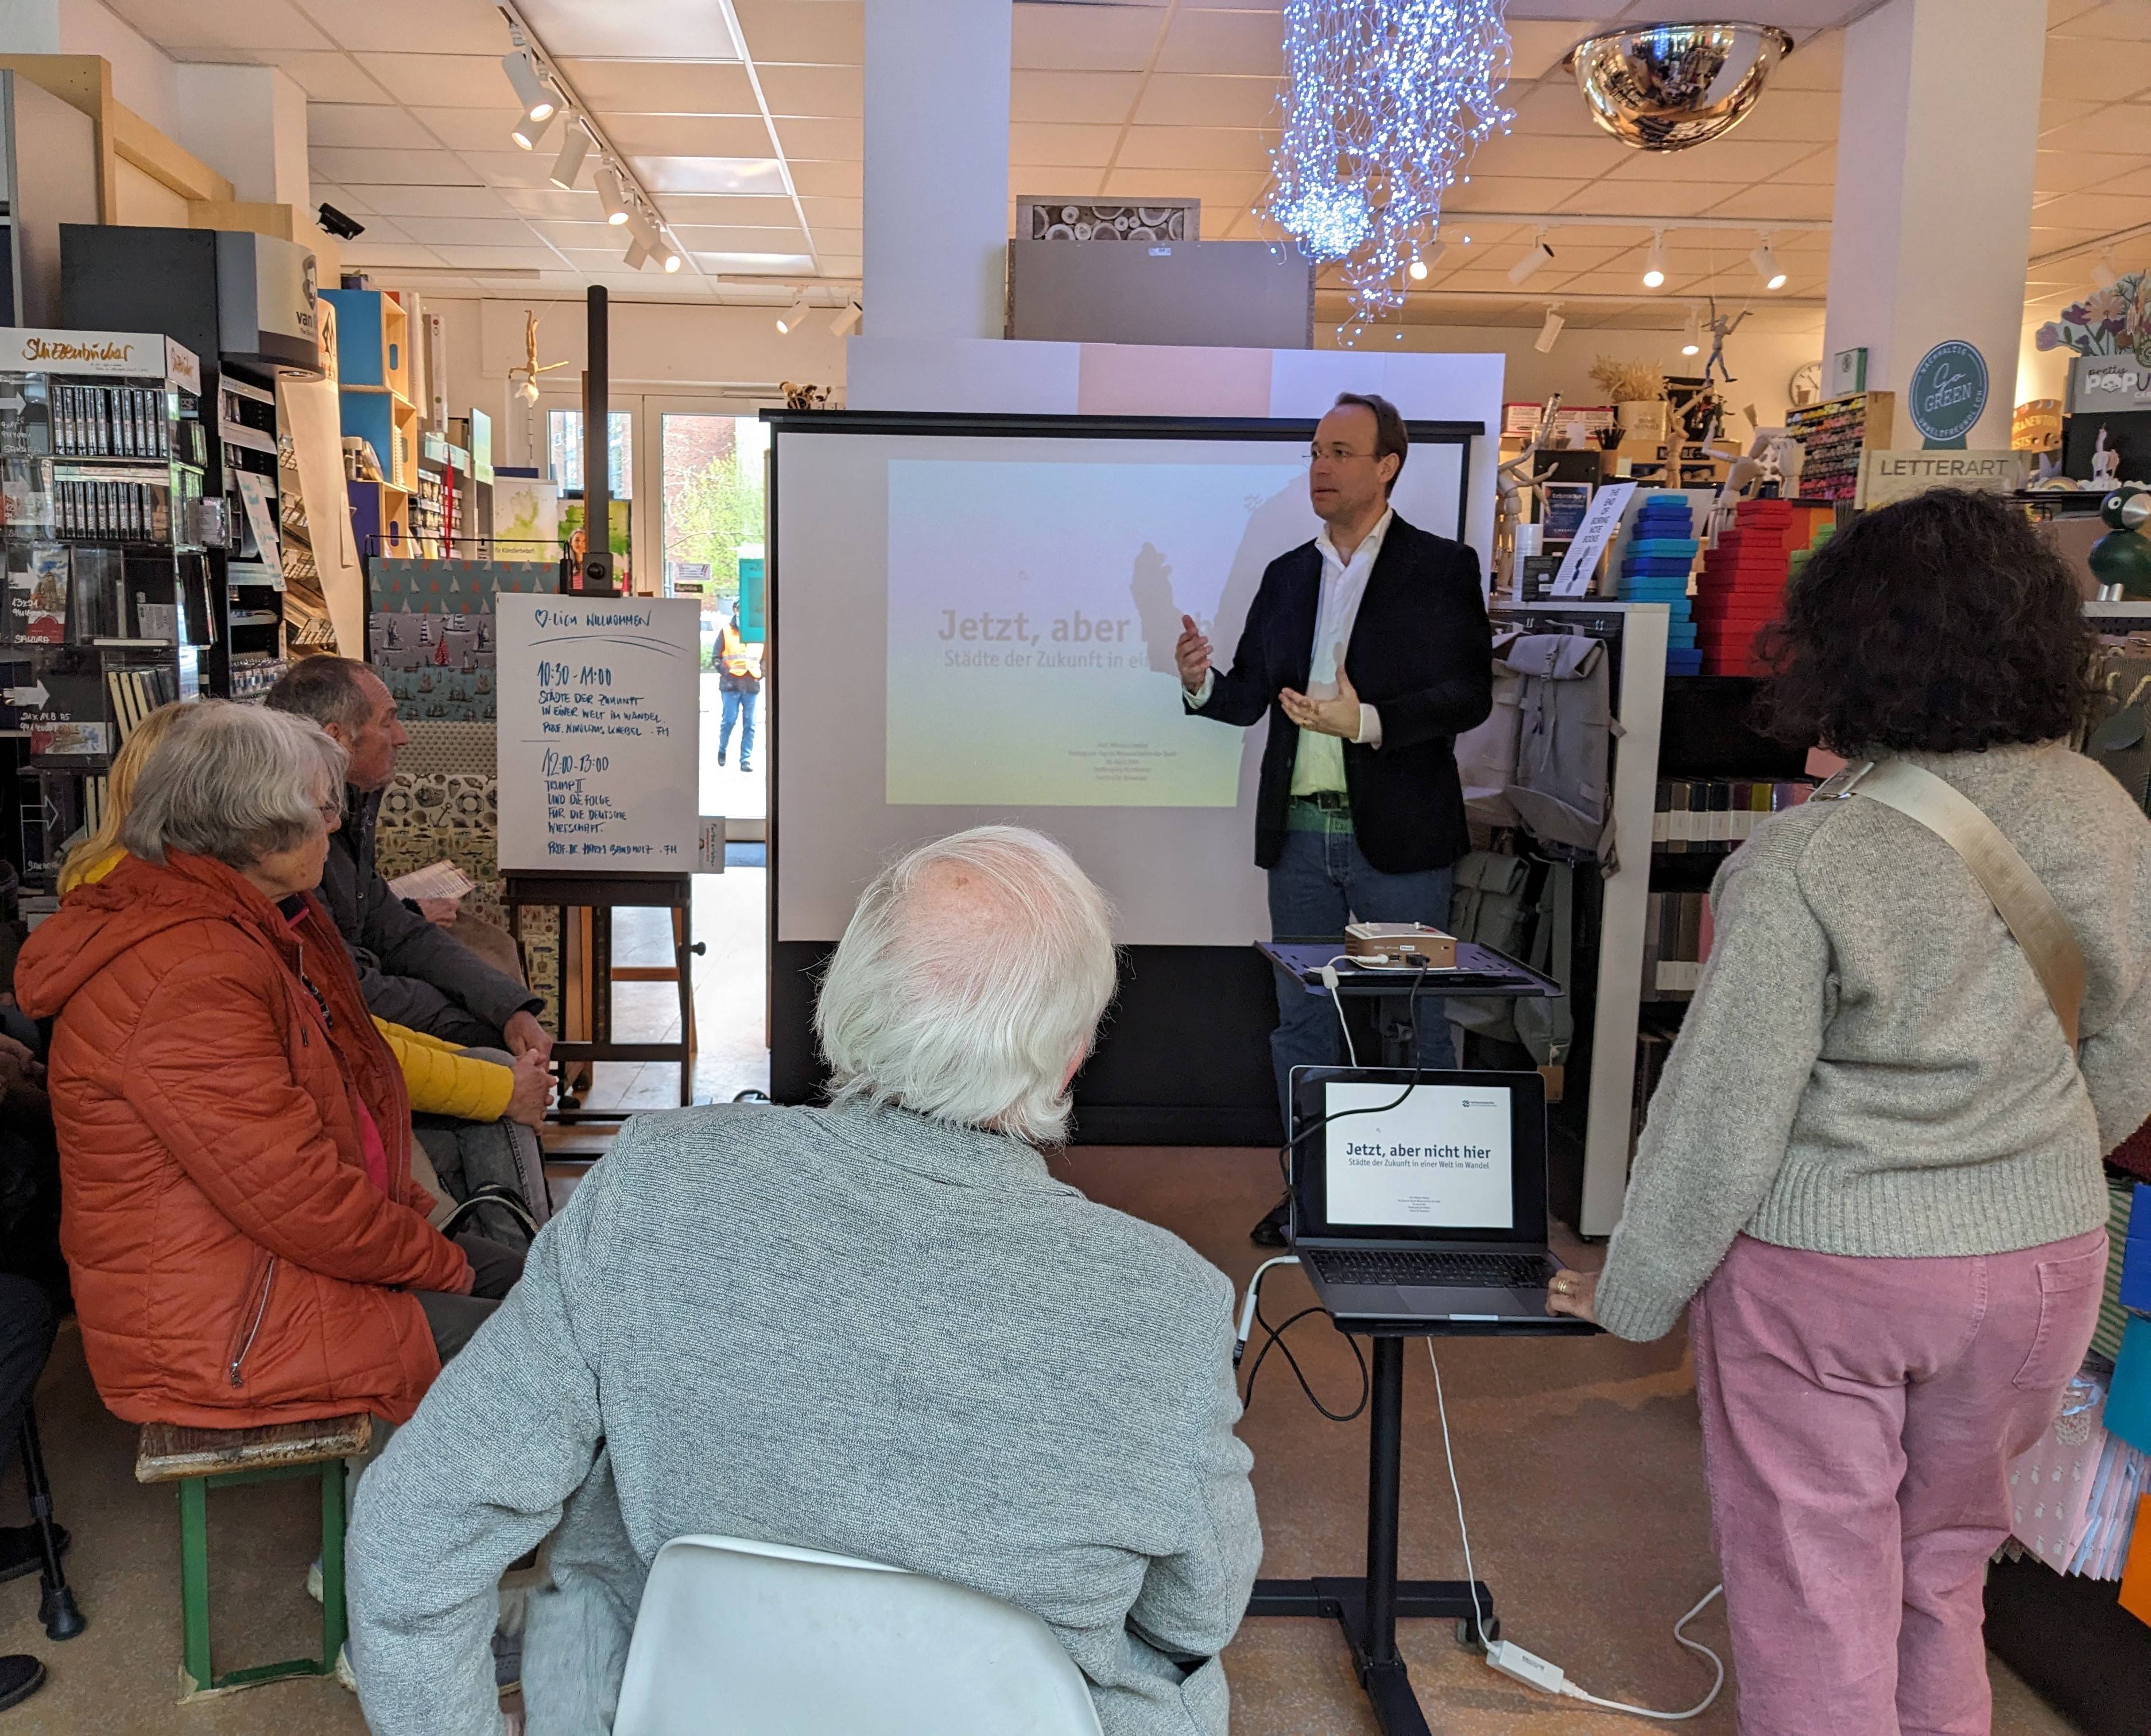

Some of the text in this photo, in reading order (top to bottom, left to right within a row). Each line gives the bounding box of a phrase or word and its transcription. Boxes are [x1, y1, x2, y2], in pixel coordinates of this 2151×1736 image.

[296, 311, 313, 327] van
[1933, 363, 1966, 393] Go
[1924, 382, 1972, 412] GREEN
[1881, 459, 2009, 476] LETTERART
[1590, 525, 1603, 533] NOTE
[1582, 534, 1600, 543] BOOKS
[587, 609, 652, 626] WILLKOMMEN
[937, 610, 1040, 646] Jetzt,
[1052, 610, 1130, 642] aber
[944, 649, 1000, 667] Städte
[1005, 650, 1032, 667] der
[1037, 650, 1102, 668] Zukunft
[1107, 652, 1123, 668] in
[537, 661, 569, 687] 10:30
[580, 666, 612, 687] 11:00
[538, 689, 645, 706] STÄDTE DER ZUKUNFT
[542, 707, 551, 716] IN
[582, 710, 606, 720] WELT
[608, 724, 642, 737] KNEBEL
[541, 747, 573, 777] 12:00
[580, 754, 609, 773] 13:00
[544, 780, 575, 792] TRUMP
[548, 793, 565, 805] UND
[548, 806, 627, 820] FÜR DIE DEUTSCHE
[1346, 1142, 1491, 1158] Jetzt, aber nicht hier
[1348, 1158, 1370, 1166] Städte
[1371, 1158, 1383, 1167] der
[1384, 1159, 1411, 1167] Zukunft
